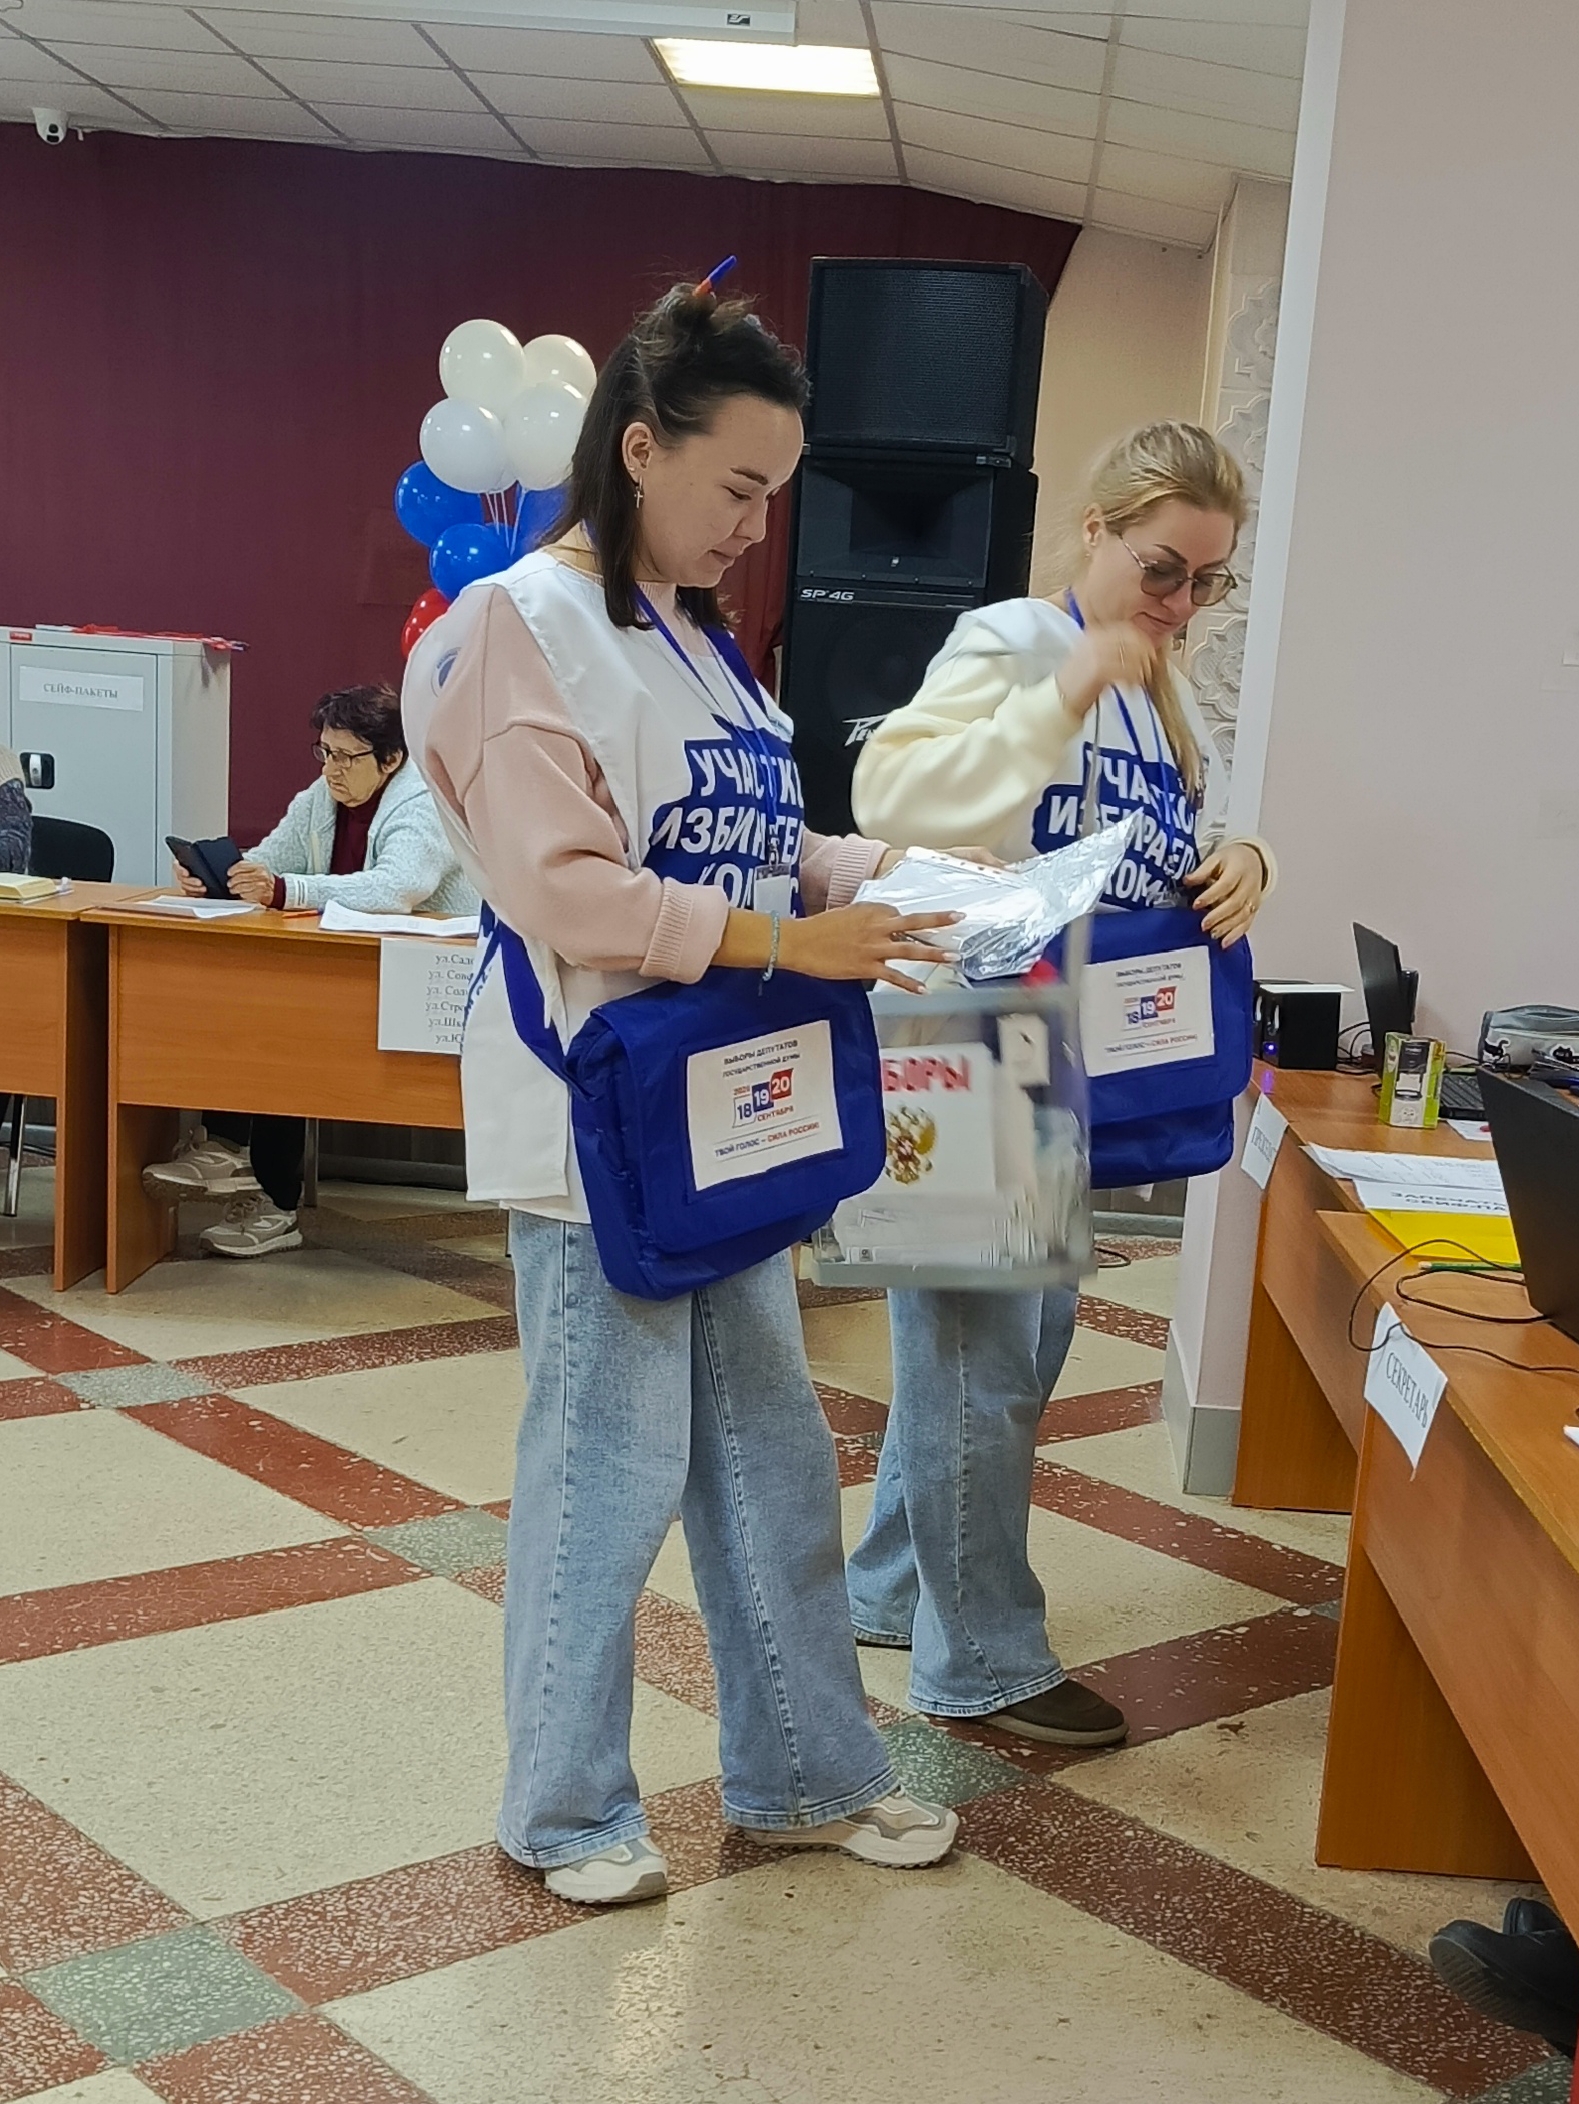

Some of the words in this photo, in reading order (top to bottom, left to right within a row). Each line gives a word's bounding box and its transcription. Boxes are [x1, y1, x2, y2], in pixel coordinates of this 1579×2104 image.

[828, 590, 855, 601] 4G
[43, 683, 118, 699] СЕЙФ-ПАКЕТЫ
[1157, 991, 1173, 1007] 20
[1141, 1001, 1156, 1015] 19
[724, 1051, 755, 1065] ВЫБОРЫ
[756, 1040, 798, 1057] ДЕПУТАТОВ
[772, 1077, 790, 1094] 20
[754, 1089, 769, 1107] 19
[737, 1103, 752, 1119] 18
[757, 1105, 794, 1122] СЕНТЯБРЯ
[767, 1133, 788, 1143] СИЛА
[1386, 1351, 1430, 1429] СЕКРЕТАРЬ
